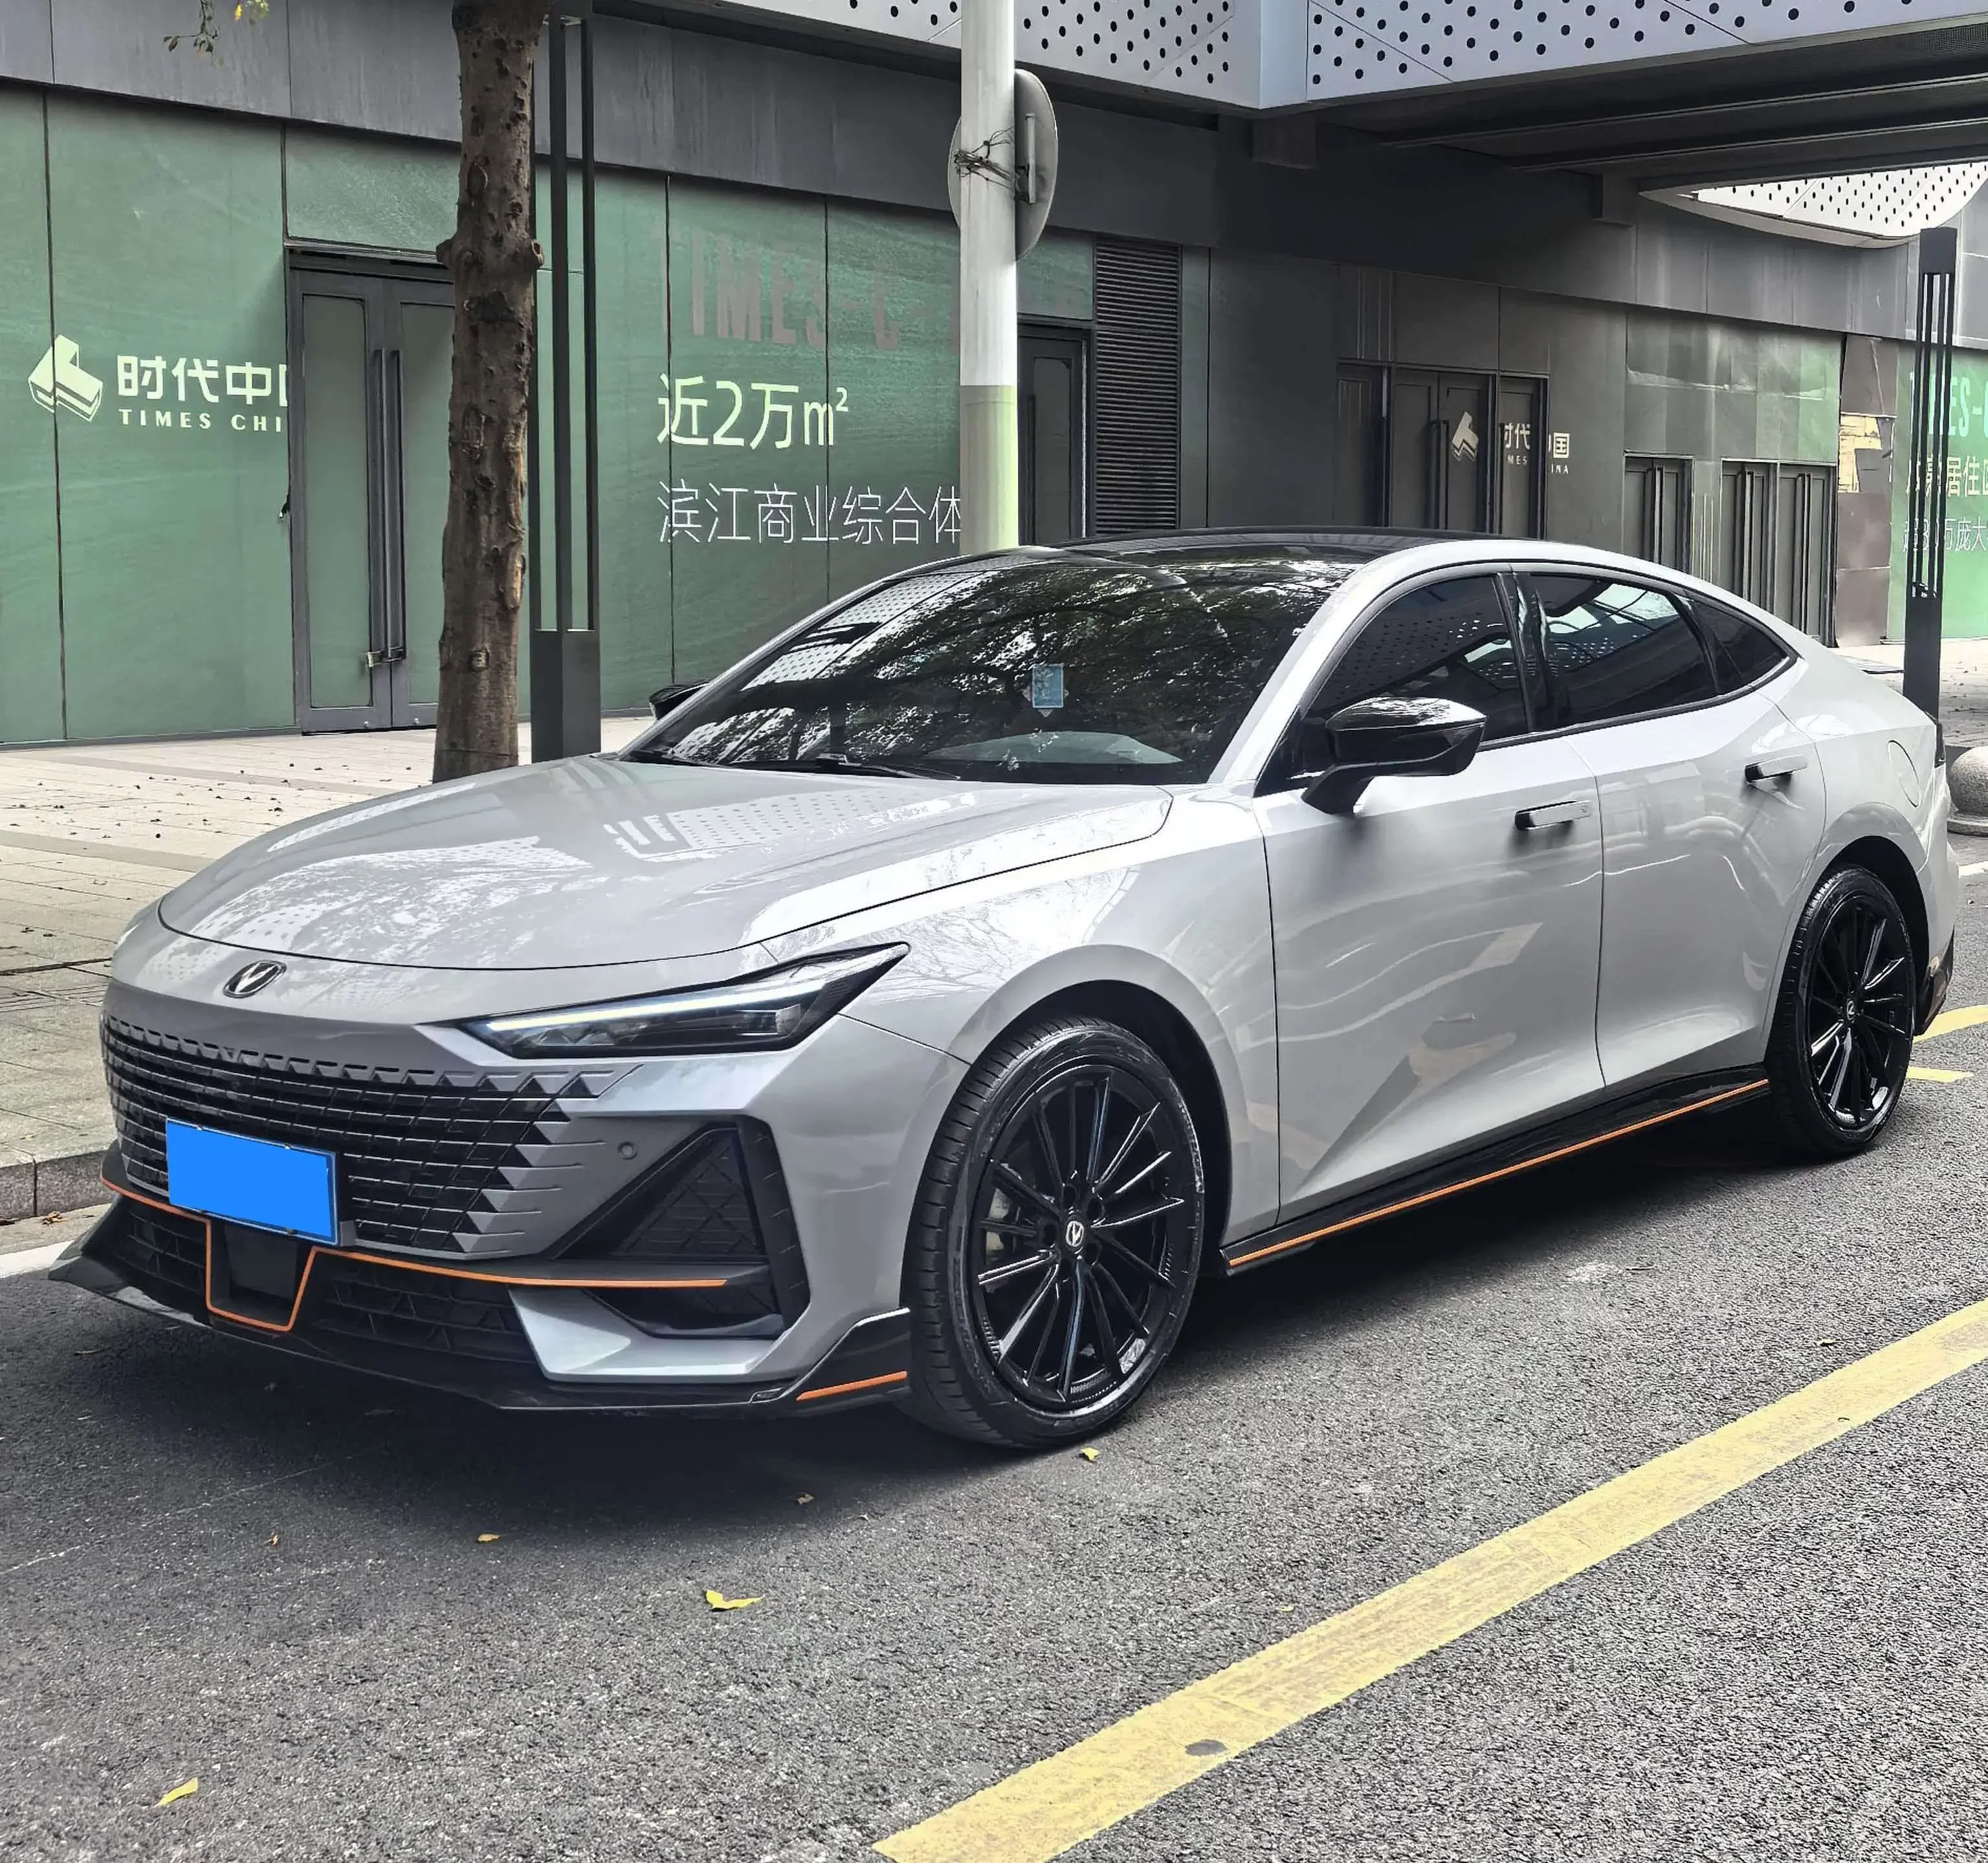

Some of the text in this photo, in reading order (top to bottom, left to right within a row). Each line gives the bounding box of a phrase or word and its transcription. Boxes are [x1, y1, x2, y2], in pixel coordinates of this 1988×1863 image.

[117, 355, 288, 407] 时代中
[118, 408, 212, 429] TIMES
[657, 478, 961, 545] 滨江商业综合体
